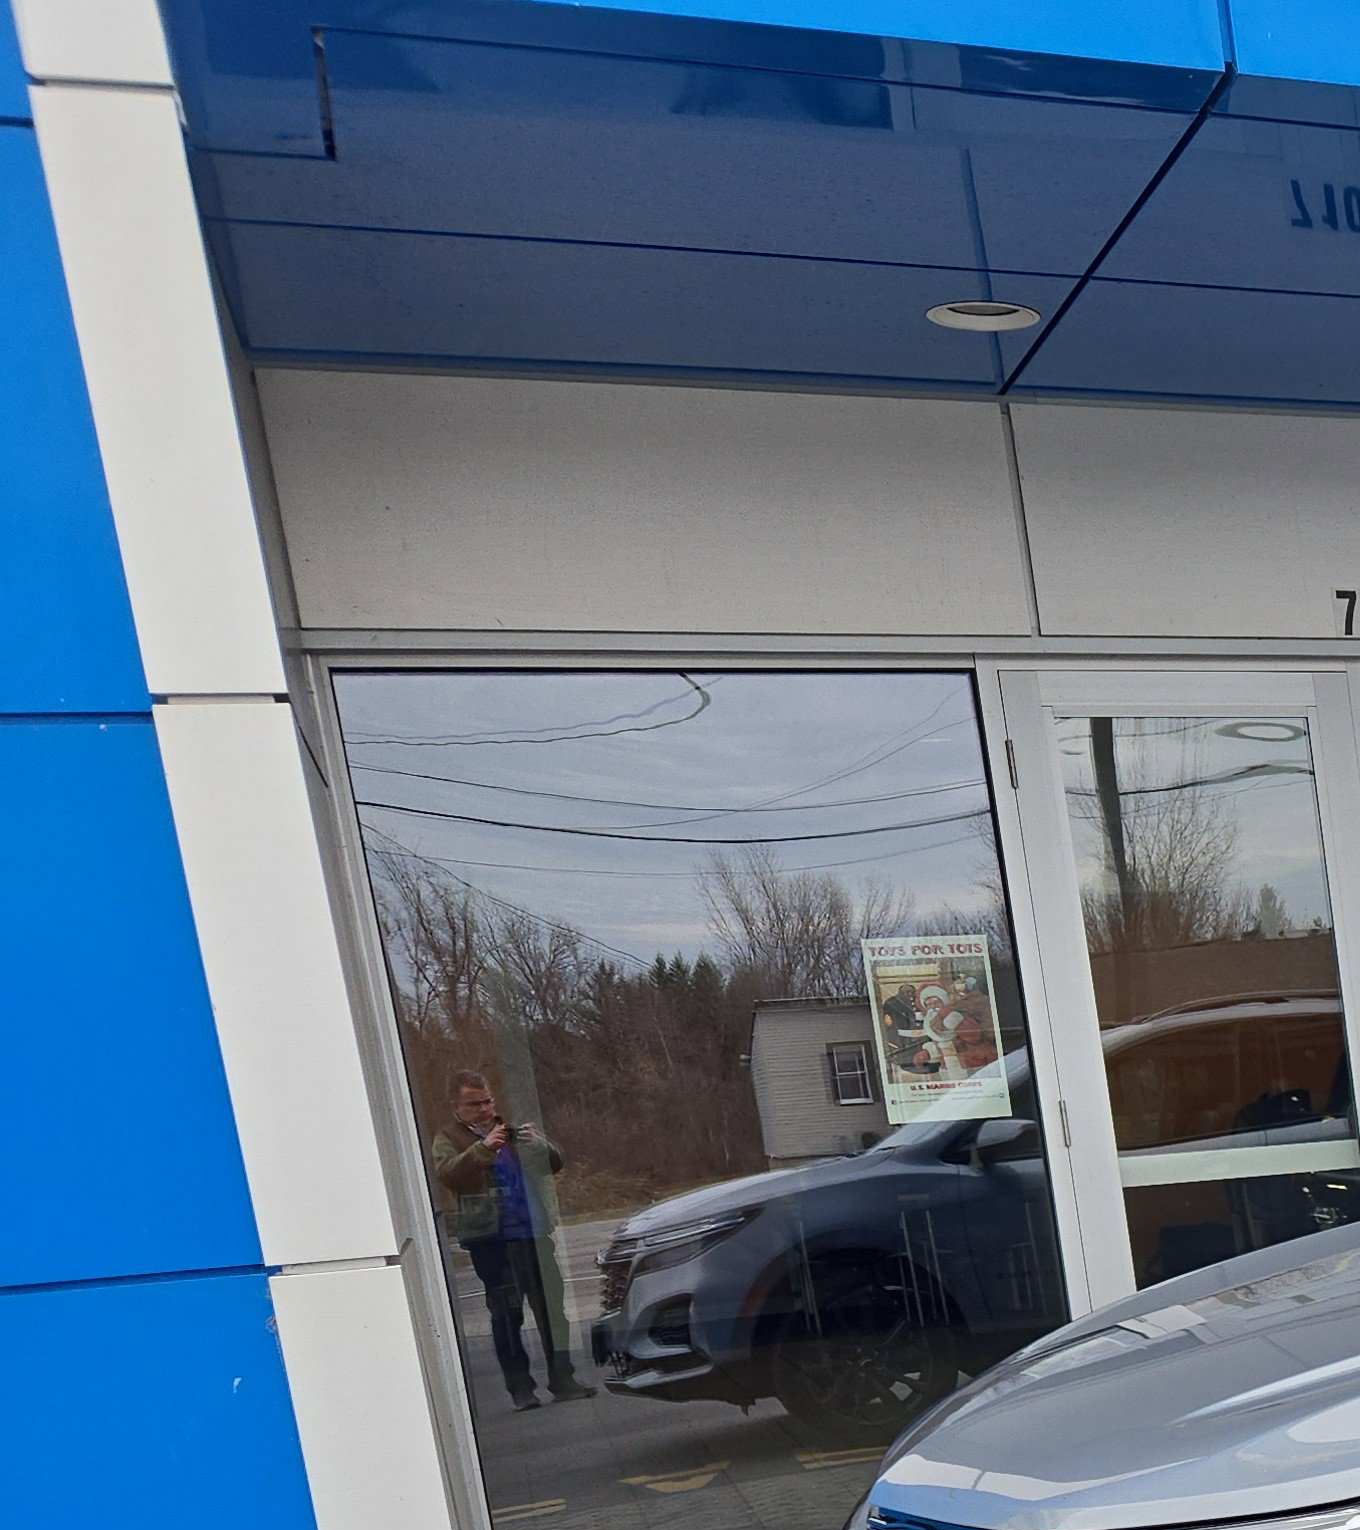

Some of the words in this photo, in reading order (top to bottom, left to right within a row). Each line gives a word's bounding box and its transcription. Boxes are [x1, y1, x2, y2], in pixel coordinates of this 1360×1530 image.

[867, 945, 904, 957] TOYS
[910, 944, 943, 956] FOR
[947, 942, 983, 955] TOTS
